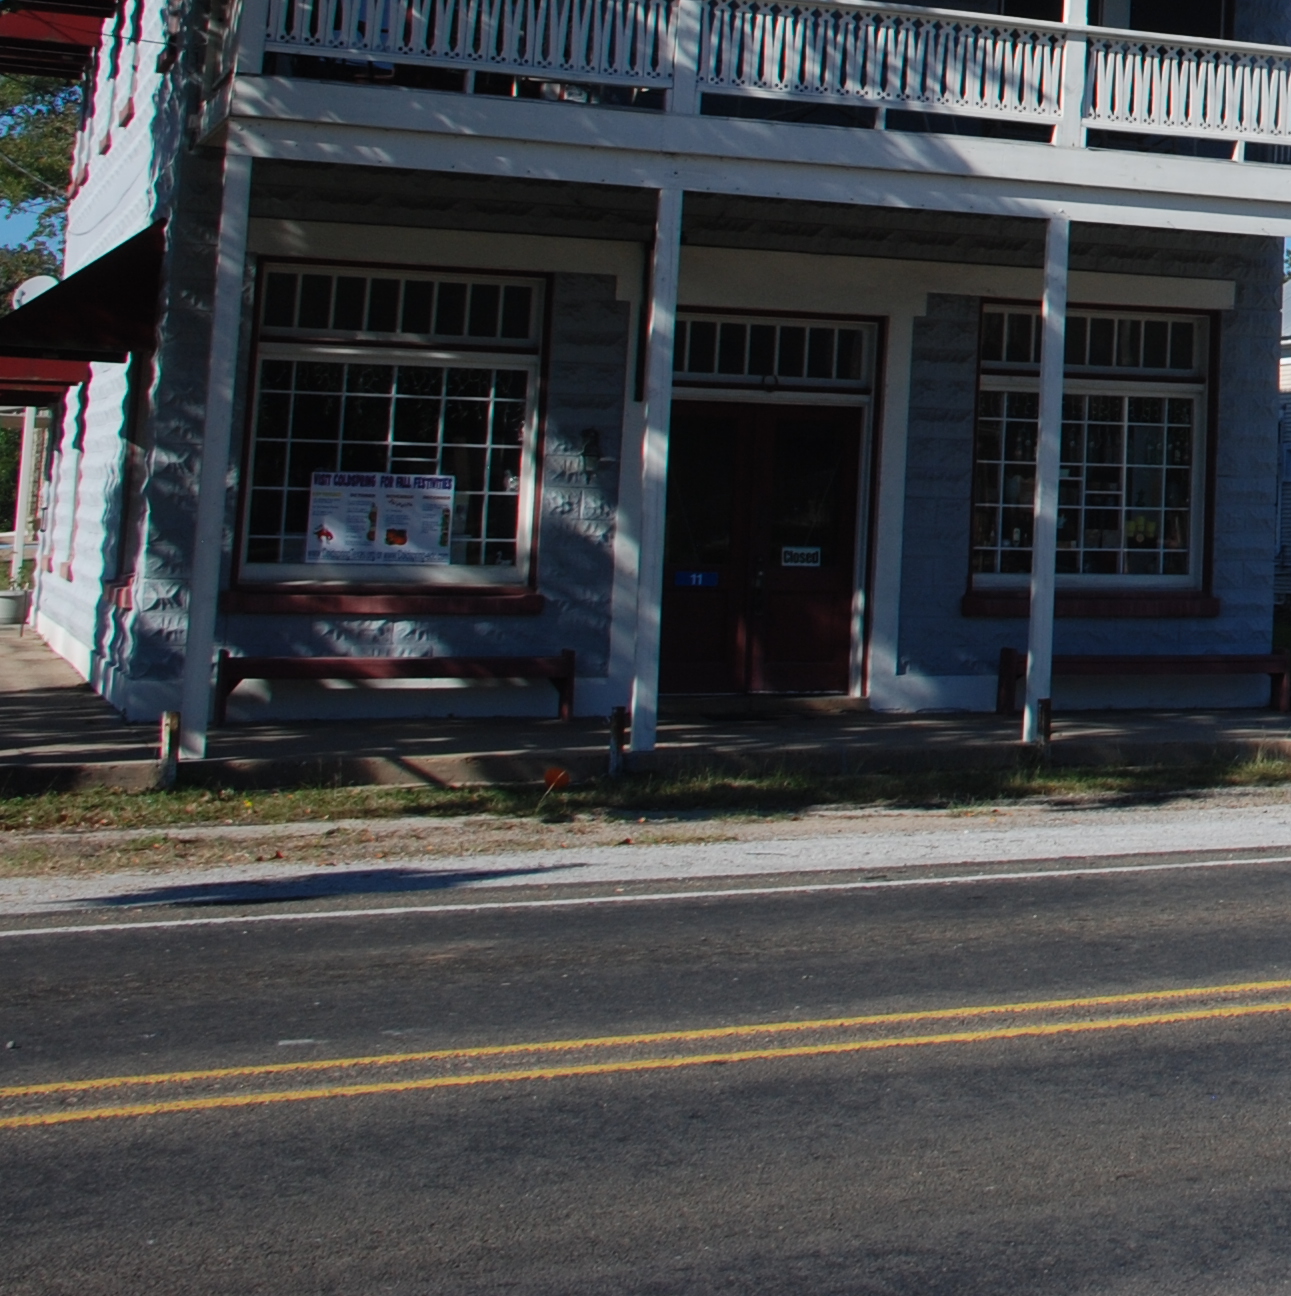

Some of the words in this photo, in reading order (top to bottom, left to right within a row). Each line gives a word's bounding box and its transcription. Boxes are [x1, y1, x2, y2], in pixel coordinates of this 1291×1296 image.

[380, 476, 394, 488] FOR
[396, 476, 411, 488] FALL
[783, 550, 819, 564] Closed
[690, 573, 702, 585] 11
